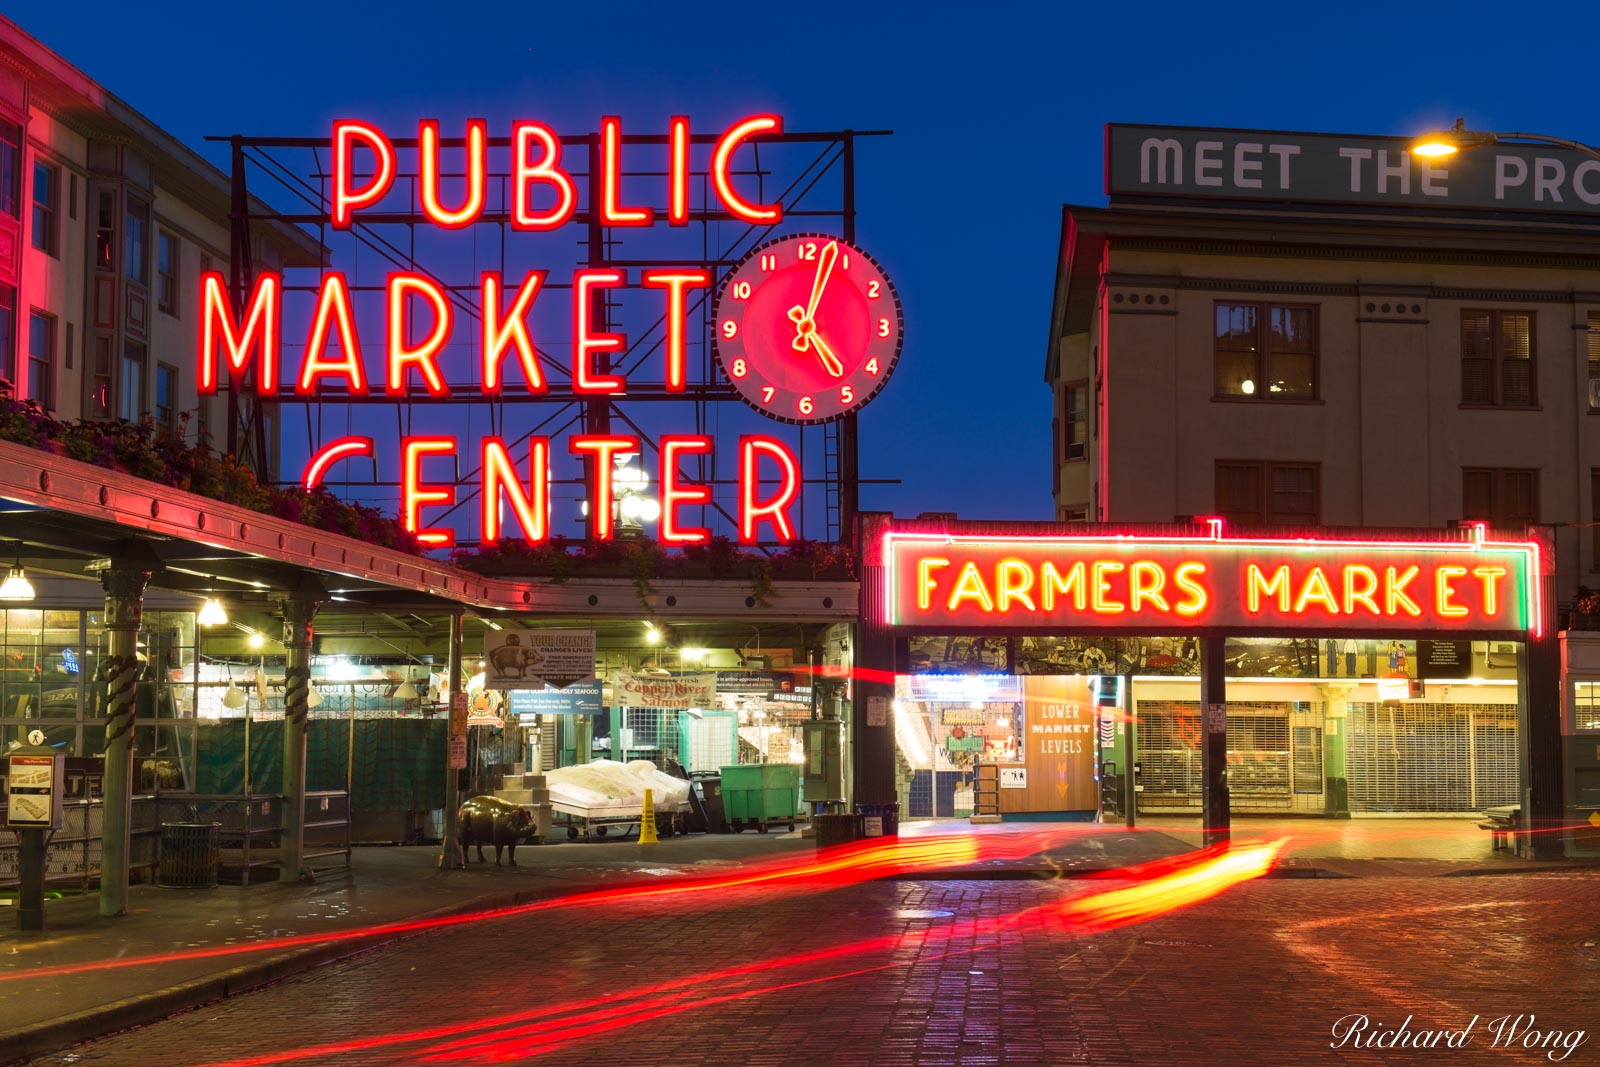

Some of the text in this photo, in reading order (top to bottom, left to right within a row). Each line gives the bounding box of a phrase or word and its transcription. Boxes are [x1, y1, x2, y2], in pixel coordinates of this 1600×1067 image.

[332, 114, 784, 231] PUBLIC
[1140, 137, 1301, 190] MEET
[1339, 147, 1449, 197] THE
[798, 243, 817, 260] 12
[761, 255, 776, 271] 11
[843, 254, 849, 270] 1
[733, 281, 751, 299] 10
[868, 281, 880, 298] 2
[197, 268, 712, 396] MARKET
[723, 320, 737, 338] 9
[878, 319, 890, 337] 3
[733, 359, 746, 377] 8
[865, 357, 879, 375] 4
[762, 387, 775, 403] 7
[840, 386, 853, 403] 5
[799, 396, 813, 414] 6
[917, 558, 1507, 617] FARMERS MARKET
[529, 635, 593, 647] YOUR CHANGE
[624, 681, 707, 696] Copper River
[641, 695, 689, 707] Salmon
[1042, 704, 1080, 719] LOWER
[1032, 724, 1091, 734] MARKET
[1041, 739, 1082, 754] LEVELS
